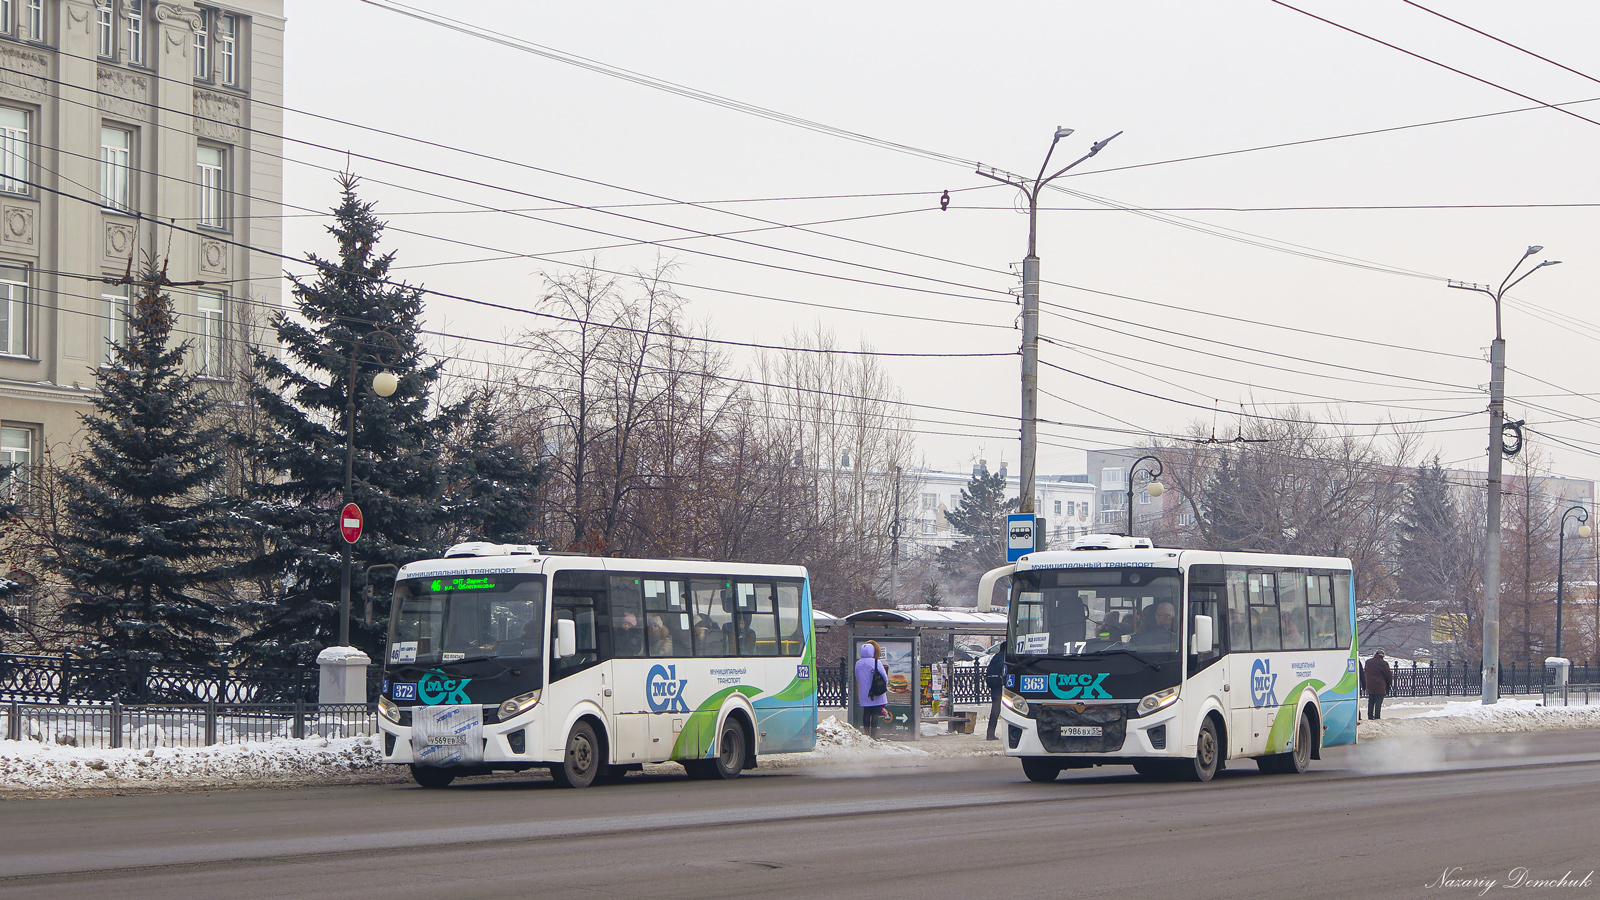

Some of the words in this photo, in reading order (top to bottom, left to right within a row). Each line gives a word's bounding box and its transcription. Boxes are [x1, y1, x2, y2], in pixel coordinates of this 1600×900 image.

[1031, 561, 1102, 570] МУНИЦИПАЛЬНЫЙ
[406, 569, 468, 579] МУНИЦИПАЛЬНЫЙ
[431, 580, 441, 591] 46
[1017, 641, 1025, 653] 17
[1063, 641, 1087, 657] 17
[391, 649, 399, 659] 46
[797, 666, 809, 678] 372
[1024, 677, 1045, 690] 363
[395, 685, 414, 698] 372
